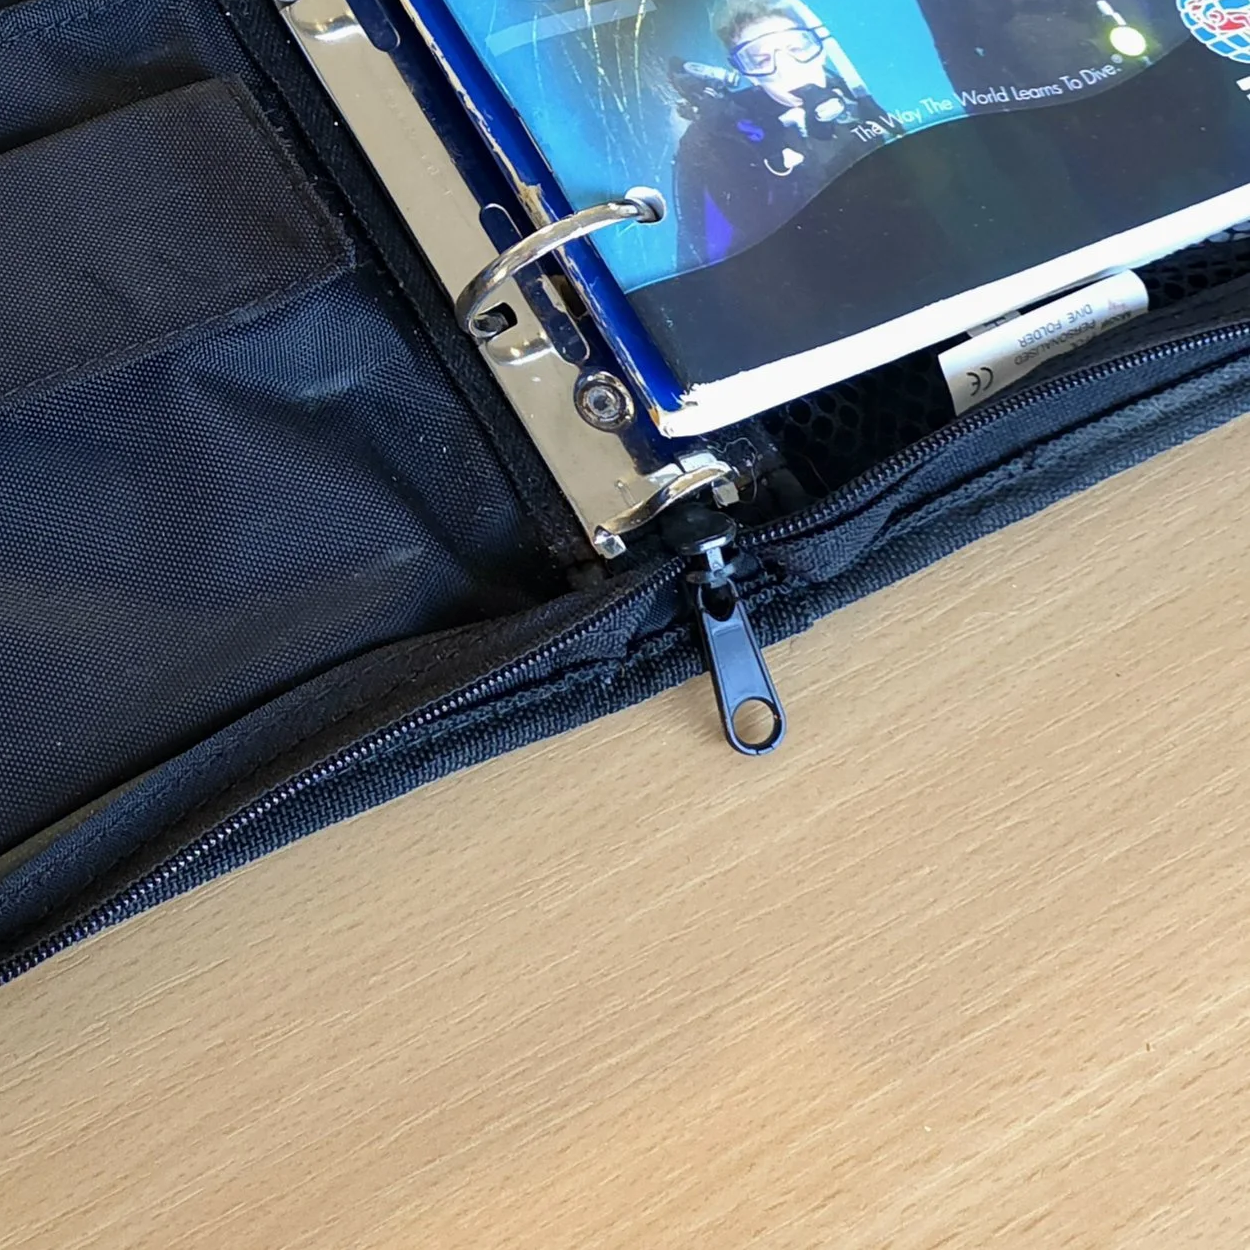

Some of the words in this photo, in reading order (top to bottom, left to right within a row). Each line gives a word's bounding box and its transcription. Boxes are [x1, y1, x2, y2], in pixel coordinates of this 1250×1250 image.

[880, 108, 924, 130] Way
[919, 95, 955, 117] The
[954, 86, 1009, 108] World
[1010, 83, 1063, 102] Learns
[1059, 75, 1083, 92] To
[1066, 303, 1094, 325] DIVE
[1017, 319, 1064, 350] FOLDER
